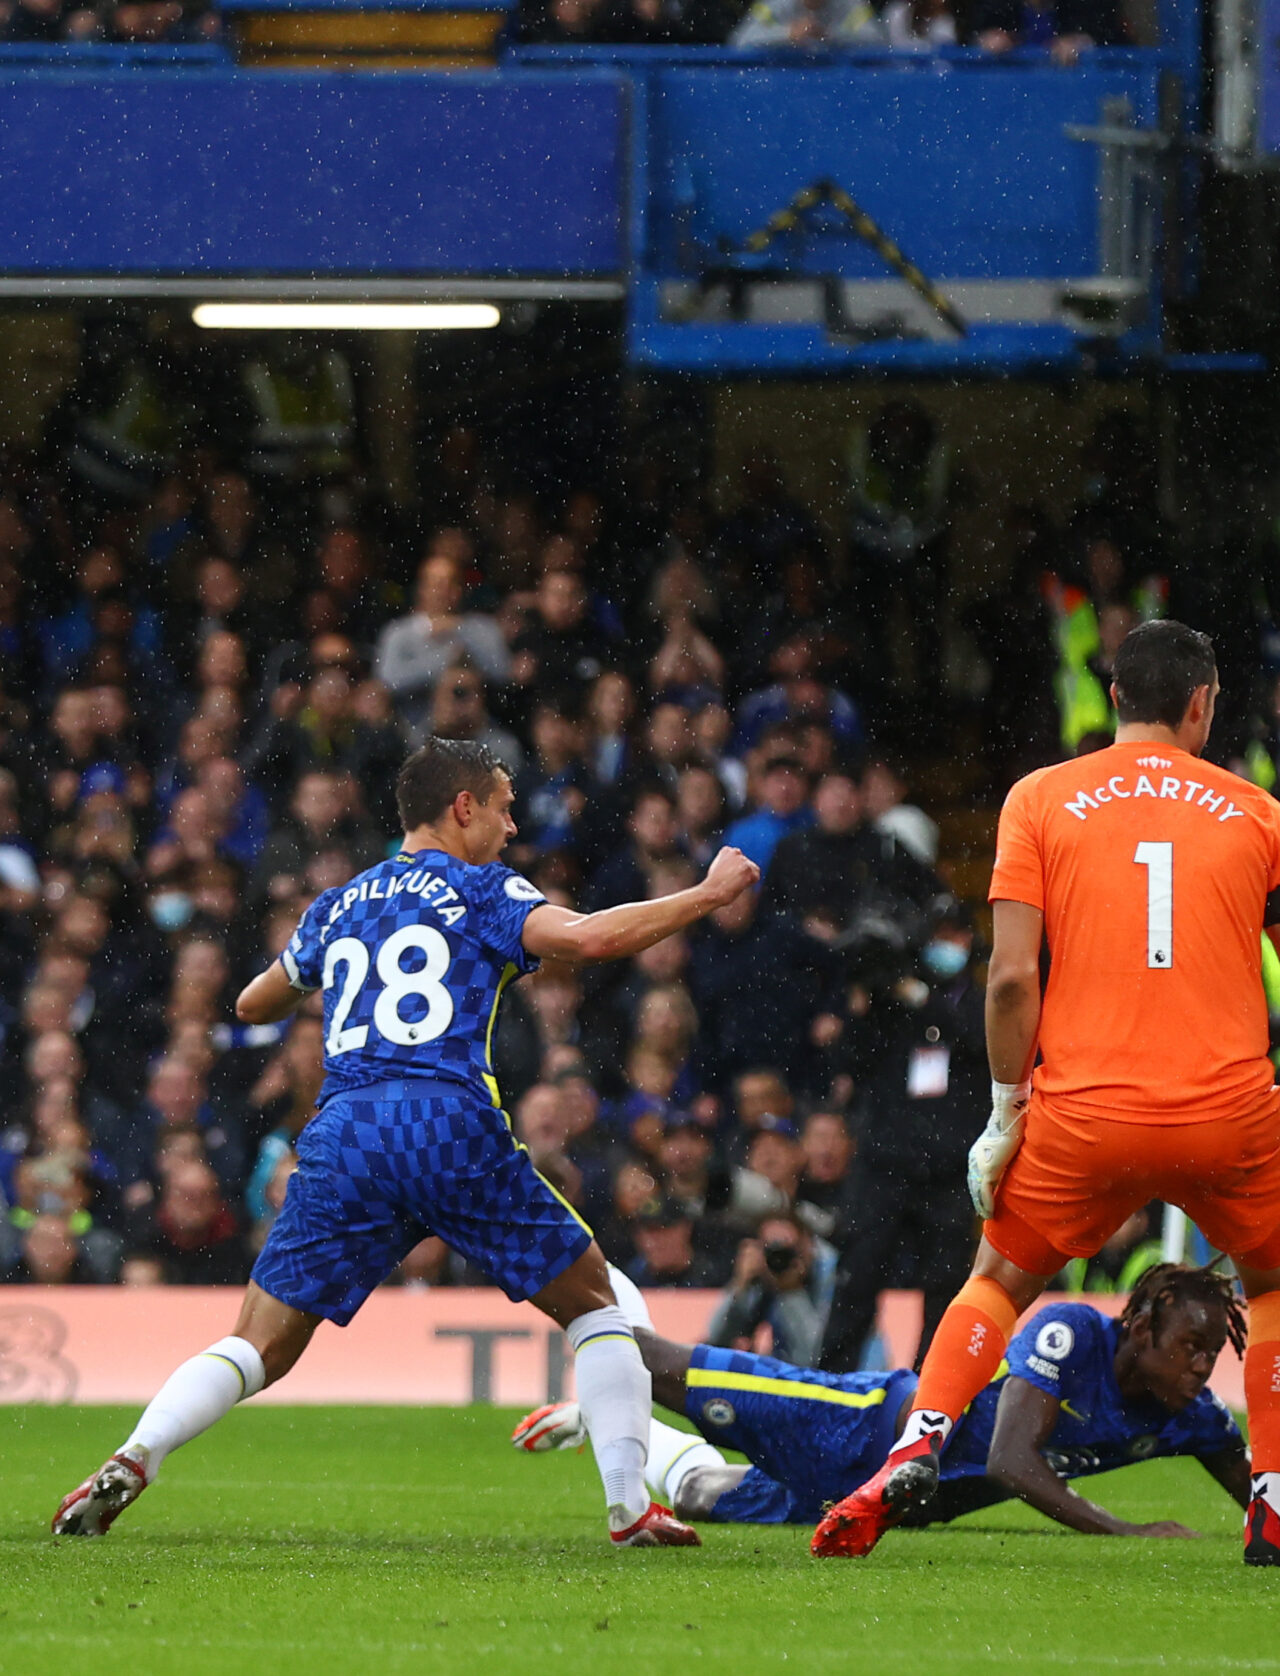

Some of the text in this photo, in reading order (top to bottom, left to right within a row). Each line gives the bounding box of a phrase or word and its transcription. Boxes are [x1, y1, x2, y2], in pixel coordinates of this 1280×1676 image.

[1064, 775, 1244, 822] McCARTHY
[1133, 841, 1173, 968] 1
[321, 924, 454, 1058] 28
